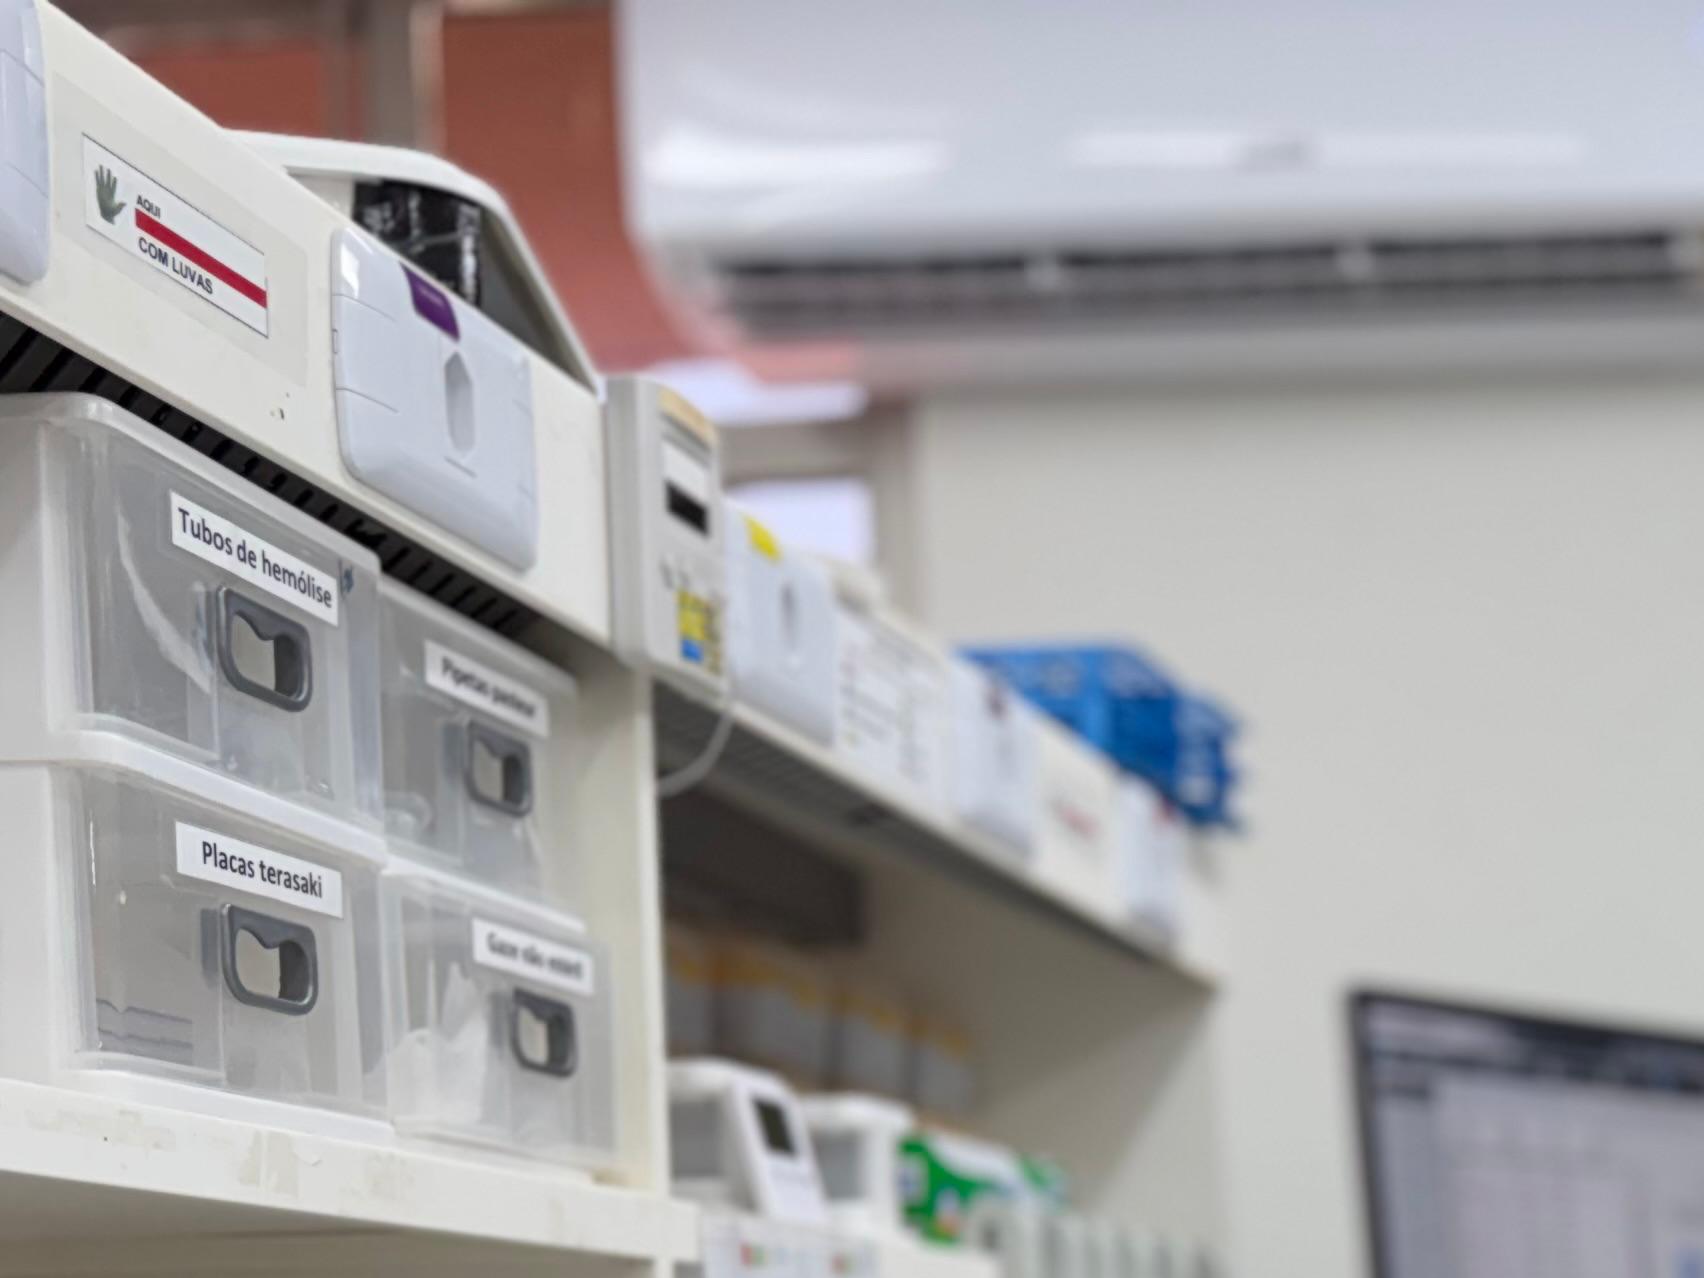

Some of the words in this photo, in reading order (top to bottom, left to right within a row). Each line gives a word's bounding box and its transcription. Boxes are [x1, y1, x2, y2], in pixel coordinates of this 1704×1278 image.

[136, 195, 161, 219] AQUI
[138, 236, 168, 267] COM
[172, 256, 213, 294] LUVAS
[178, 507, 233, 556] Tubos
[237, 540, 257, 569] de
[262, 550, 332, 608] hemólise
[202, 841, 255, 878] Placas
[259, 860, 323, 899] terasaki
